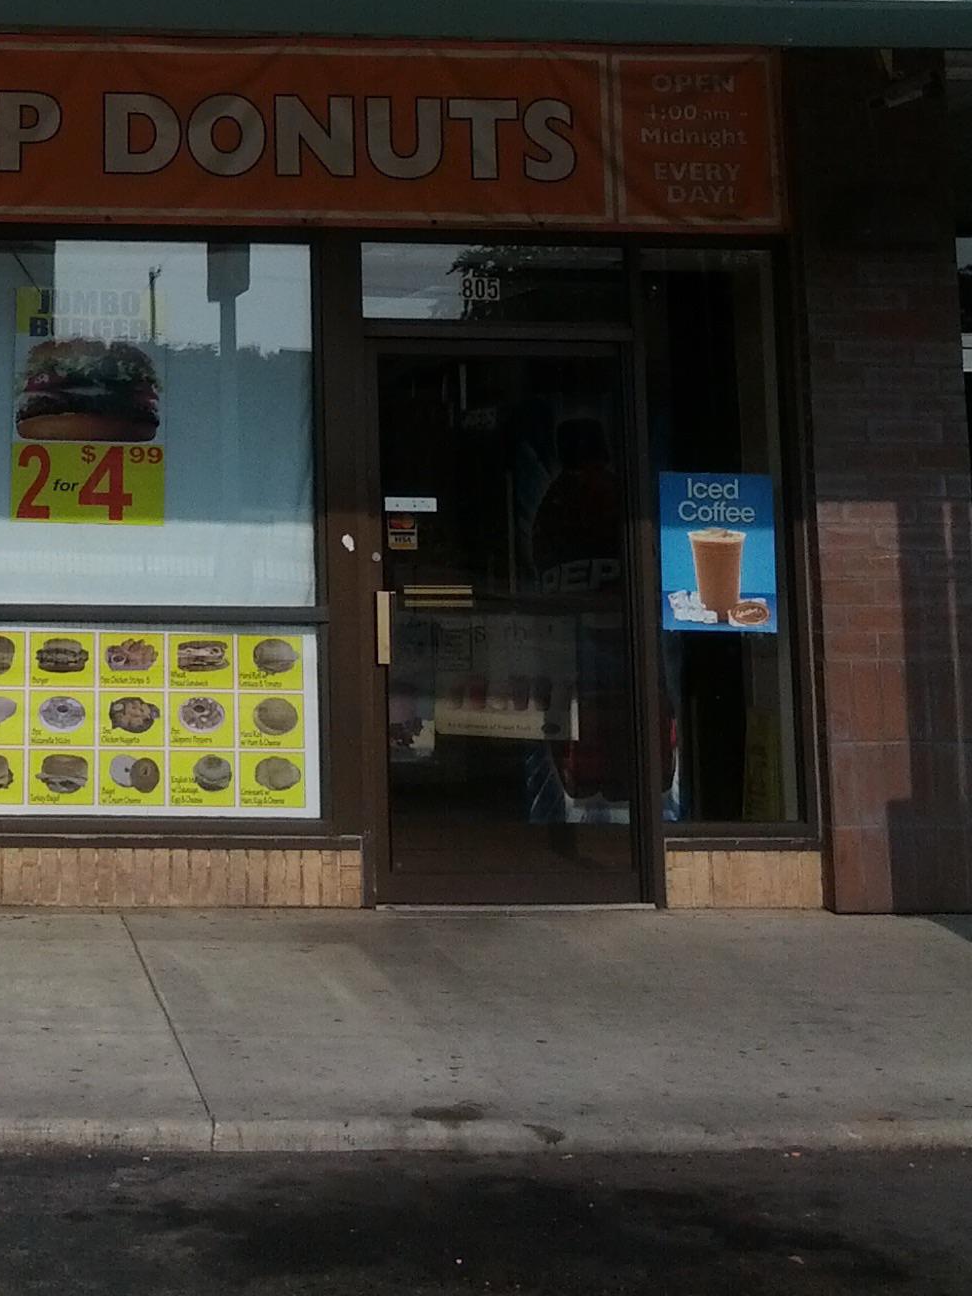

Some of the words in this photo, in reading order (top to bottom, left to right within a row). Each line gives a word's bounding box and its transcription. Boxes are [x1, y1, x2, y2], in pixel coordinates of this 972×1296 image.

[652, 74, 734, 92] OPEN
[103, 92, 577, 182] DONUTS
[640, 127, 748, 149] Midnight
[654, 162, 740, 181] EVERY
[462, 277, 498, 299] 805
[38, 289, 140, 315] JUMBO
[15, 444, 51, 520] 2
[53, 477, 79, 493] for
[686, 477, 739, 500] Iced
[678, 500, 756, 524] Coffee
